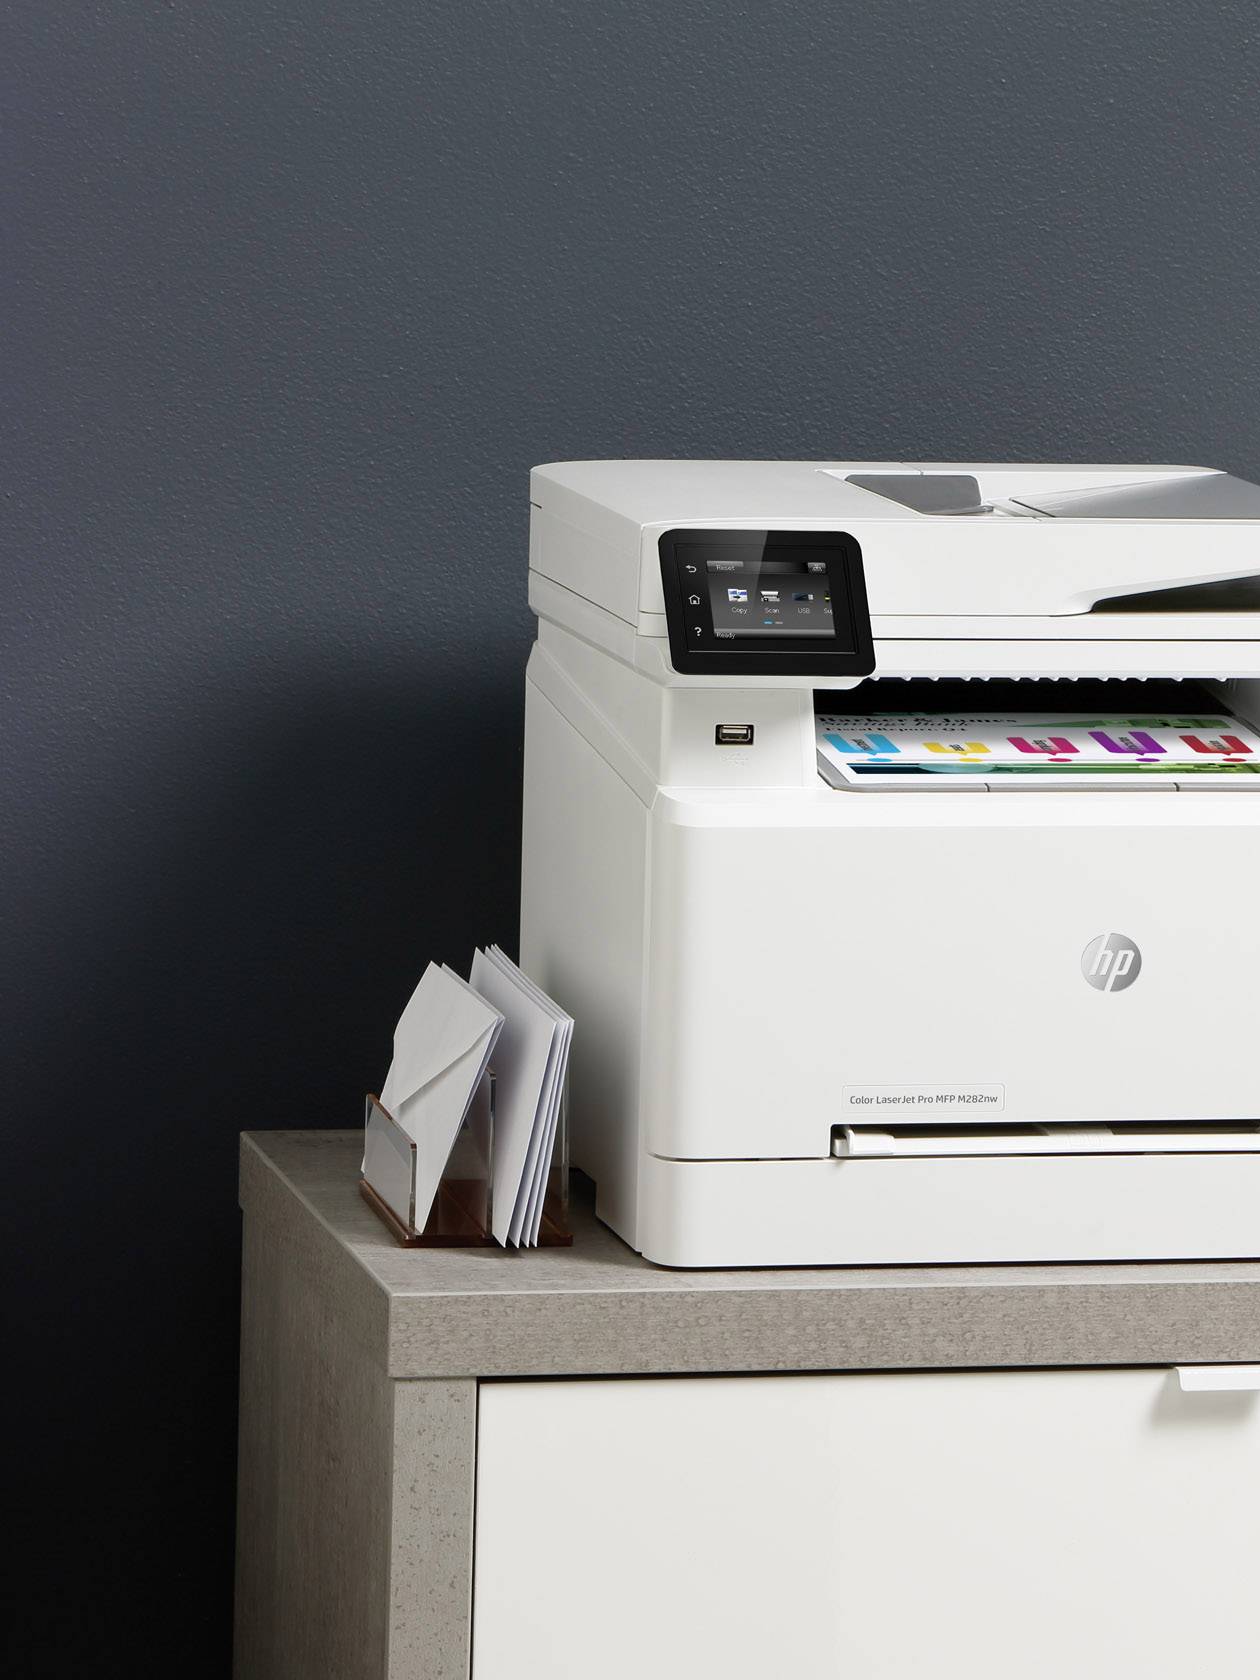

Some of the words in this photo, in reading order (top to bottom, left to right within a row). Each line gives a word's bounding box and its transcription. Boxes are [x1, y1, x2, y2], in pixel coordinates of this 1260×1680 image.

[731, 606, 748, 615] Copy
[764, 606, 780, 614] Scan
[797, 606, 811, 614] USB
[716, 631, 736, 640] Ready
[1086, 932, 1137, 992] hp
[849, 1095, 874, 1104] Color
[876, 1094, 915, 1105] LaserJet
[917, 1095, 935, 1104] Pro
[936, 1094, 956, 1104] MFP
[957, 1094, 999, 1104] M282nw
